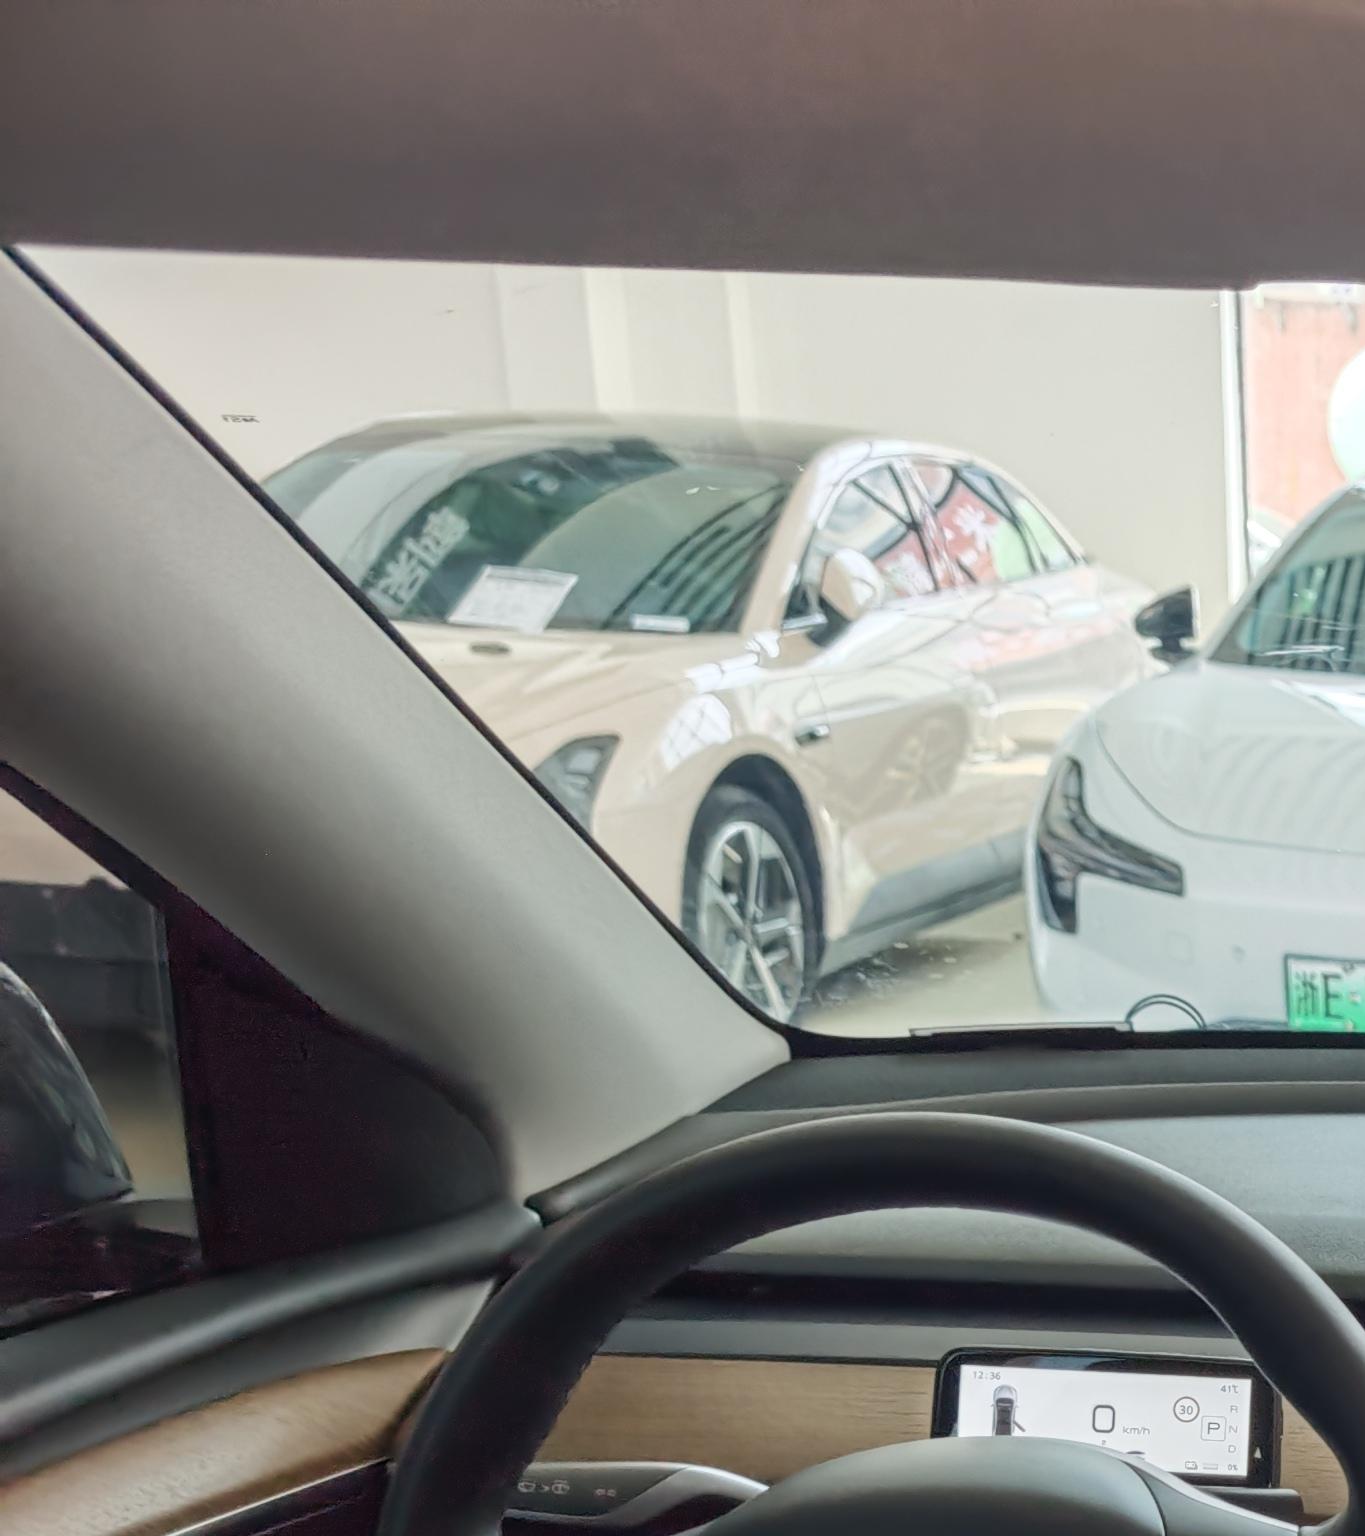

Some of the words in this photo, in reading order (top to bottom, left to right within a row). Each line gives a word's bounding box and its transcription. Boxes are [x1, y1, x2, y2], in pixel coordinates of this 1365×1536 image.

[973, 1370, 1001, 1381] 12:36
[1179, 1405, 1194, 1415] 30
[1122, 1426, 1151, 1436] km/h
[1206, 1422, 1221, 1435] P
